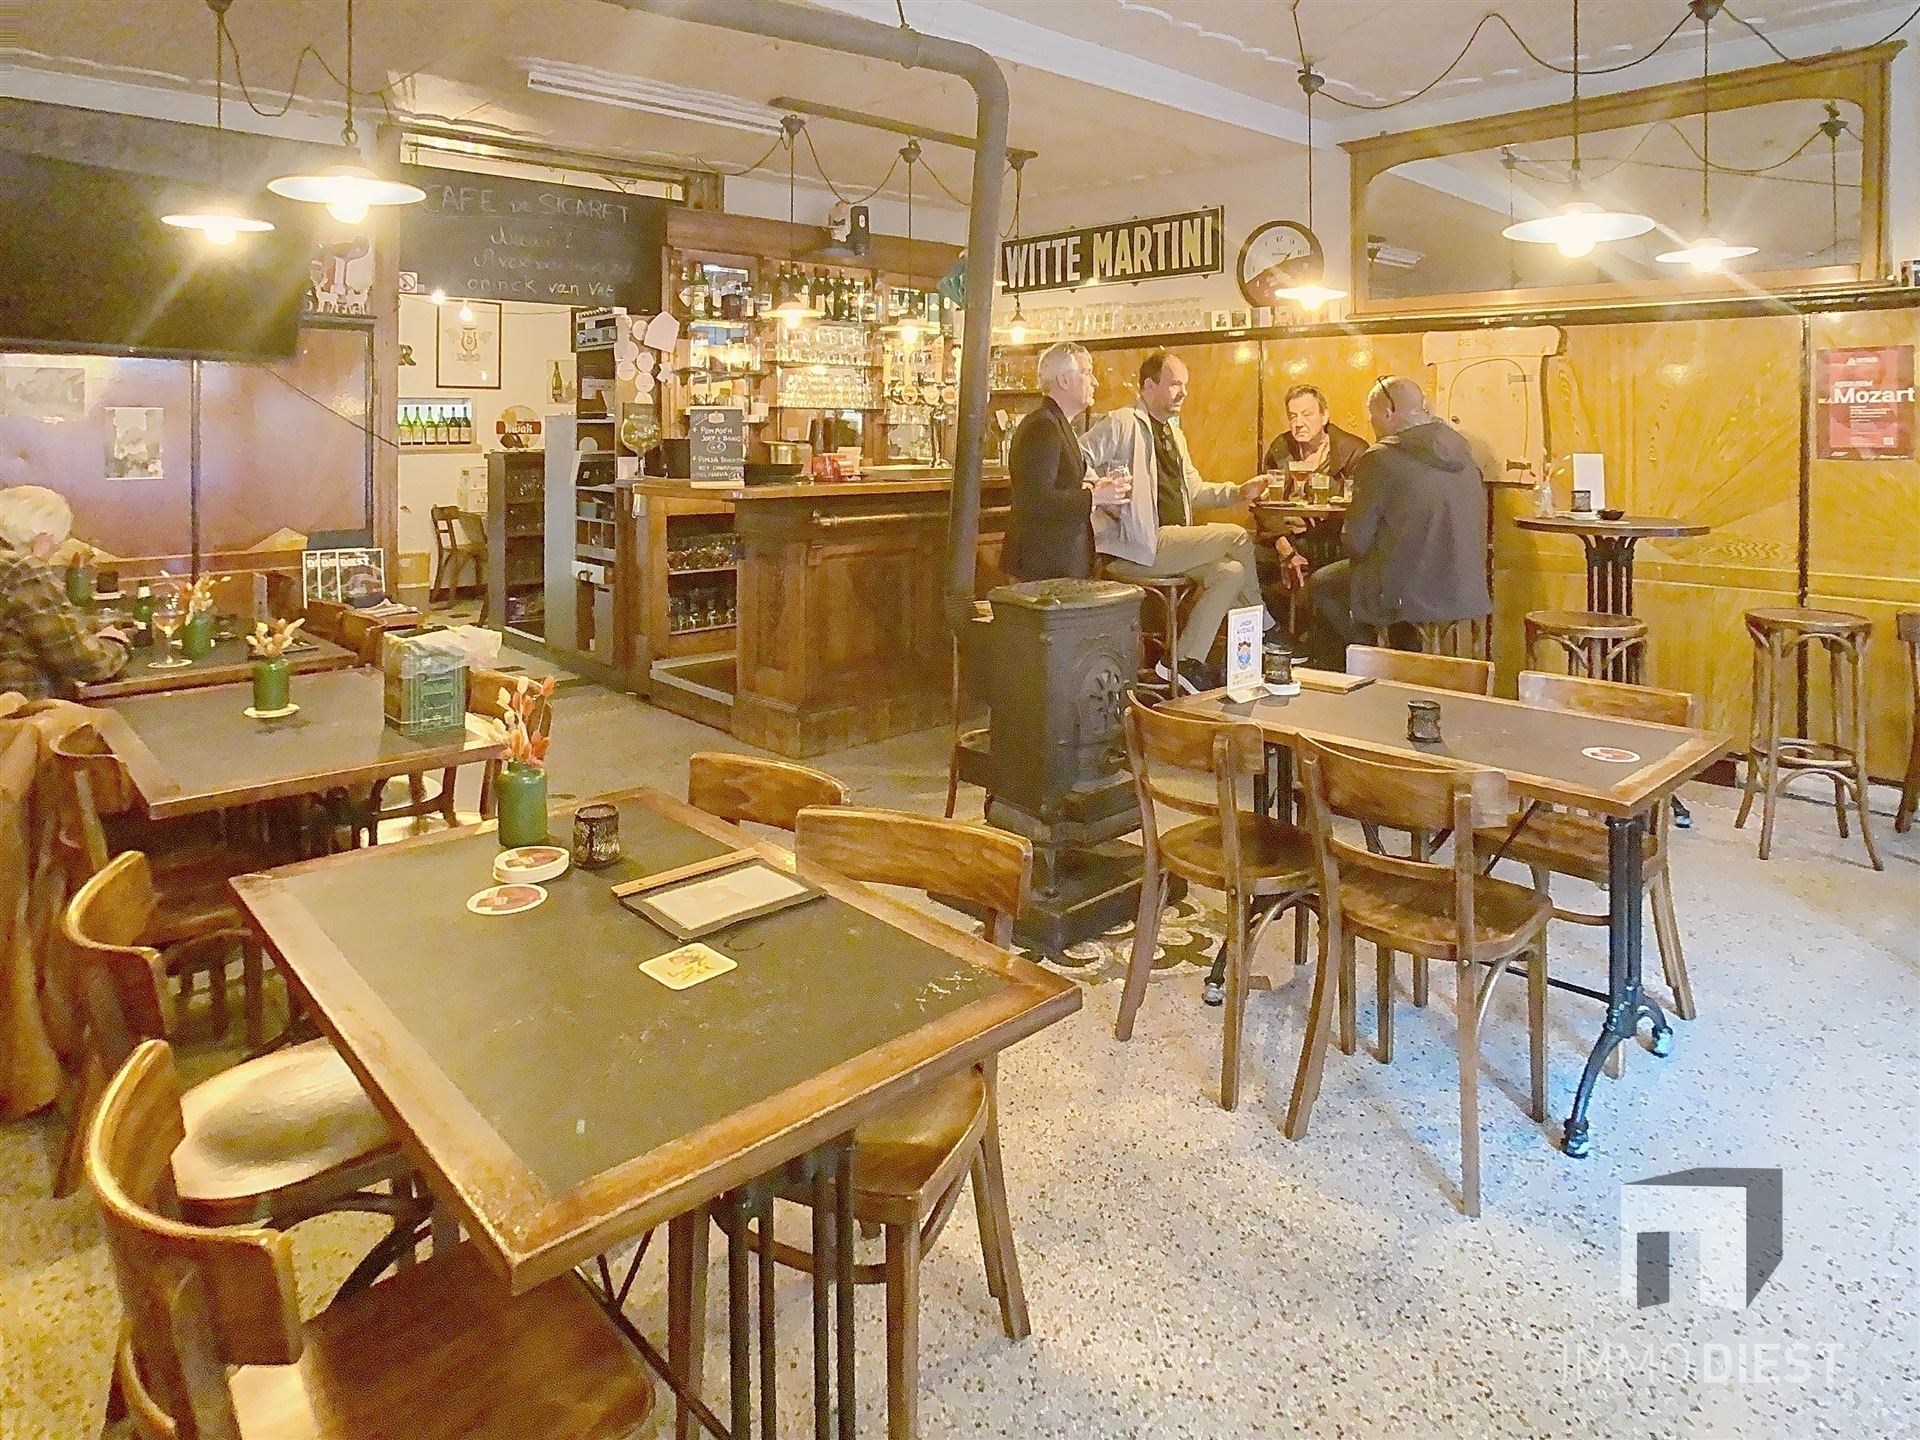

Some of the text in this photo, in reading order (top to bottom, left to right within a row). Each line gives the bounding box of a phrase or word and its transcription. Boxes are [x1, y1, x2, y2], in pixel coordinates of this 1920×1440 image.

[1005, 216, 1212, 289] WITTE MARTINI
[1834, 387, 1915, 404] Mozart
